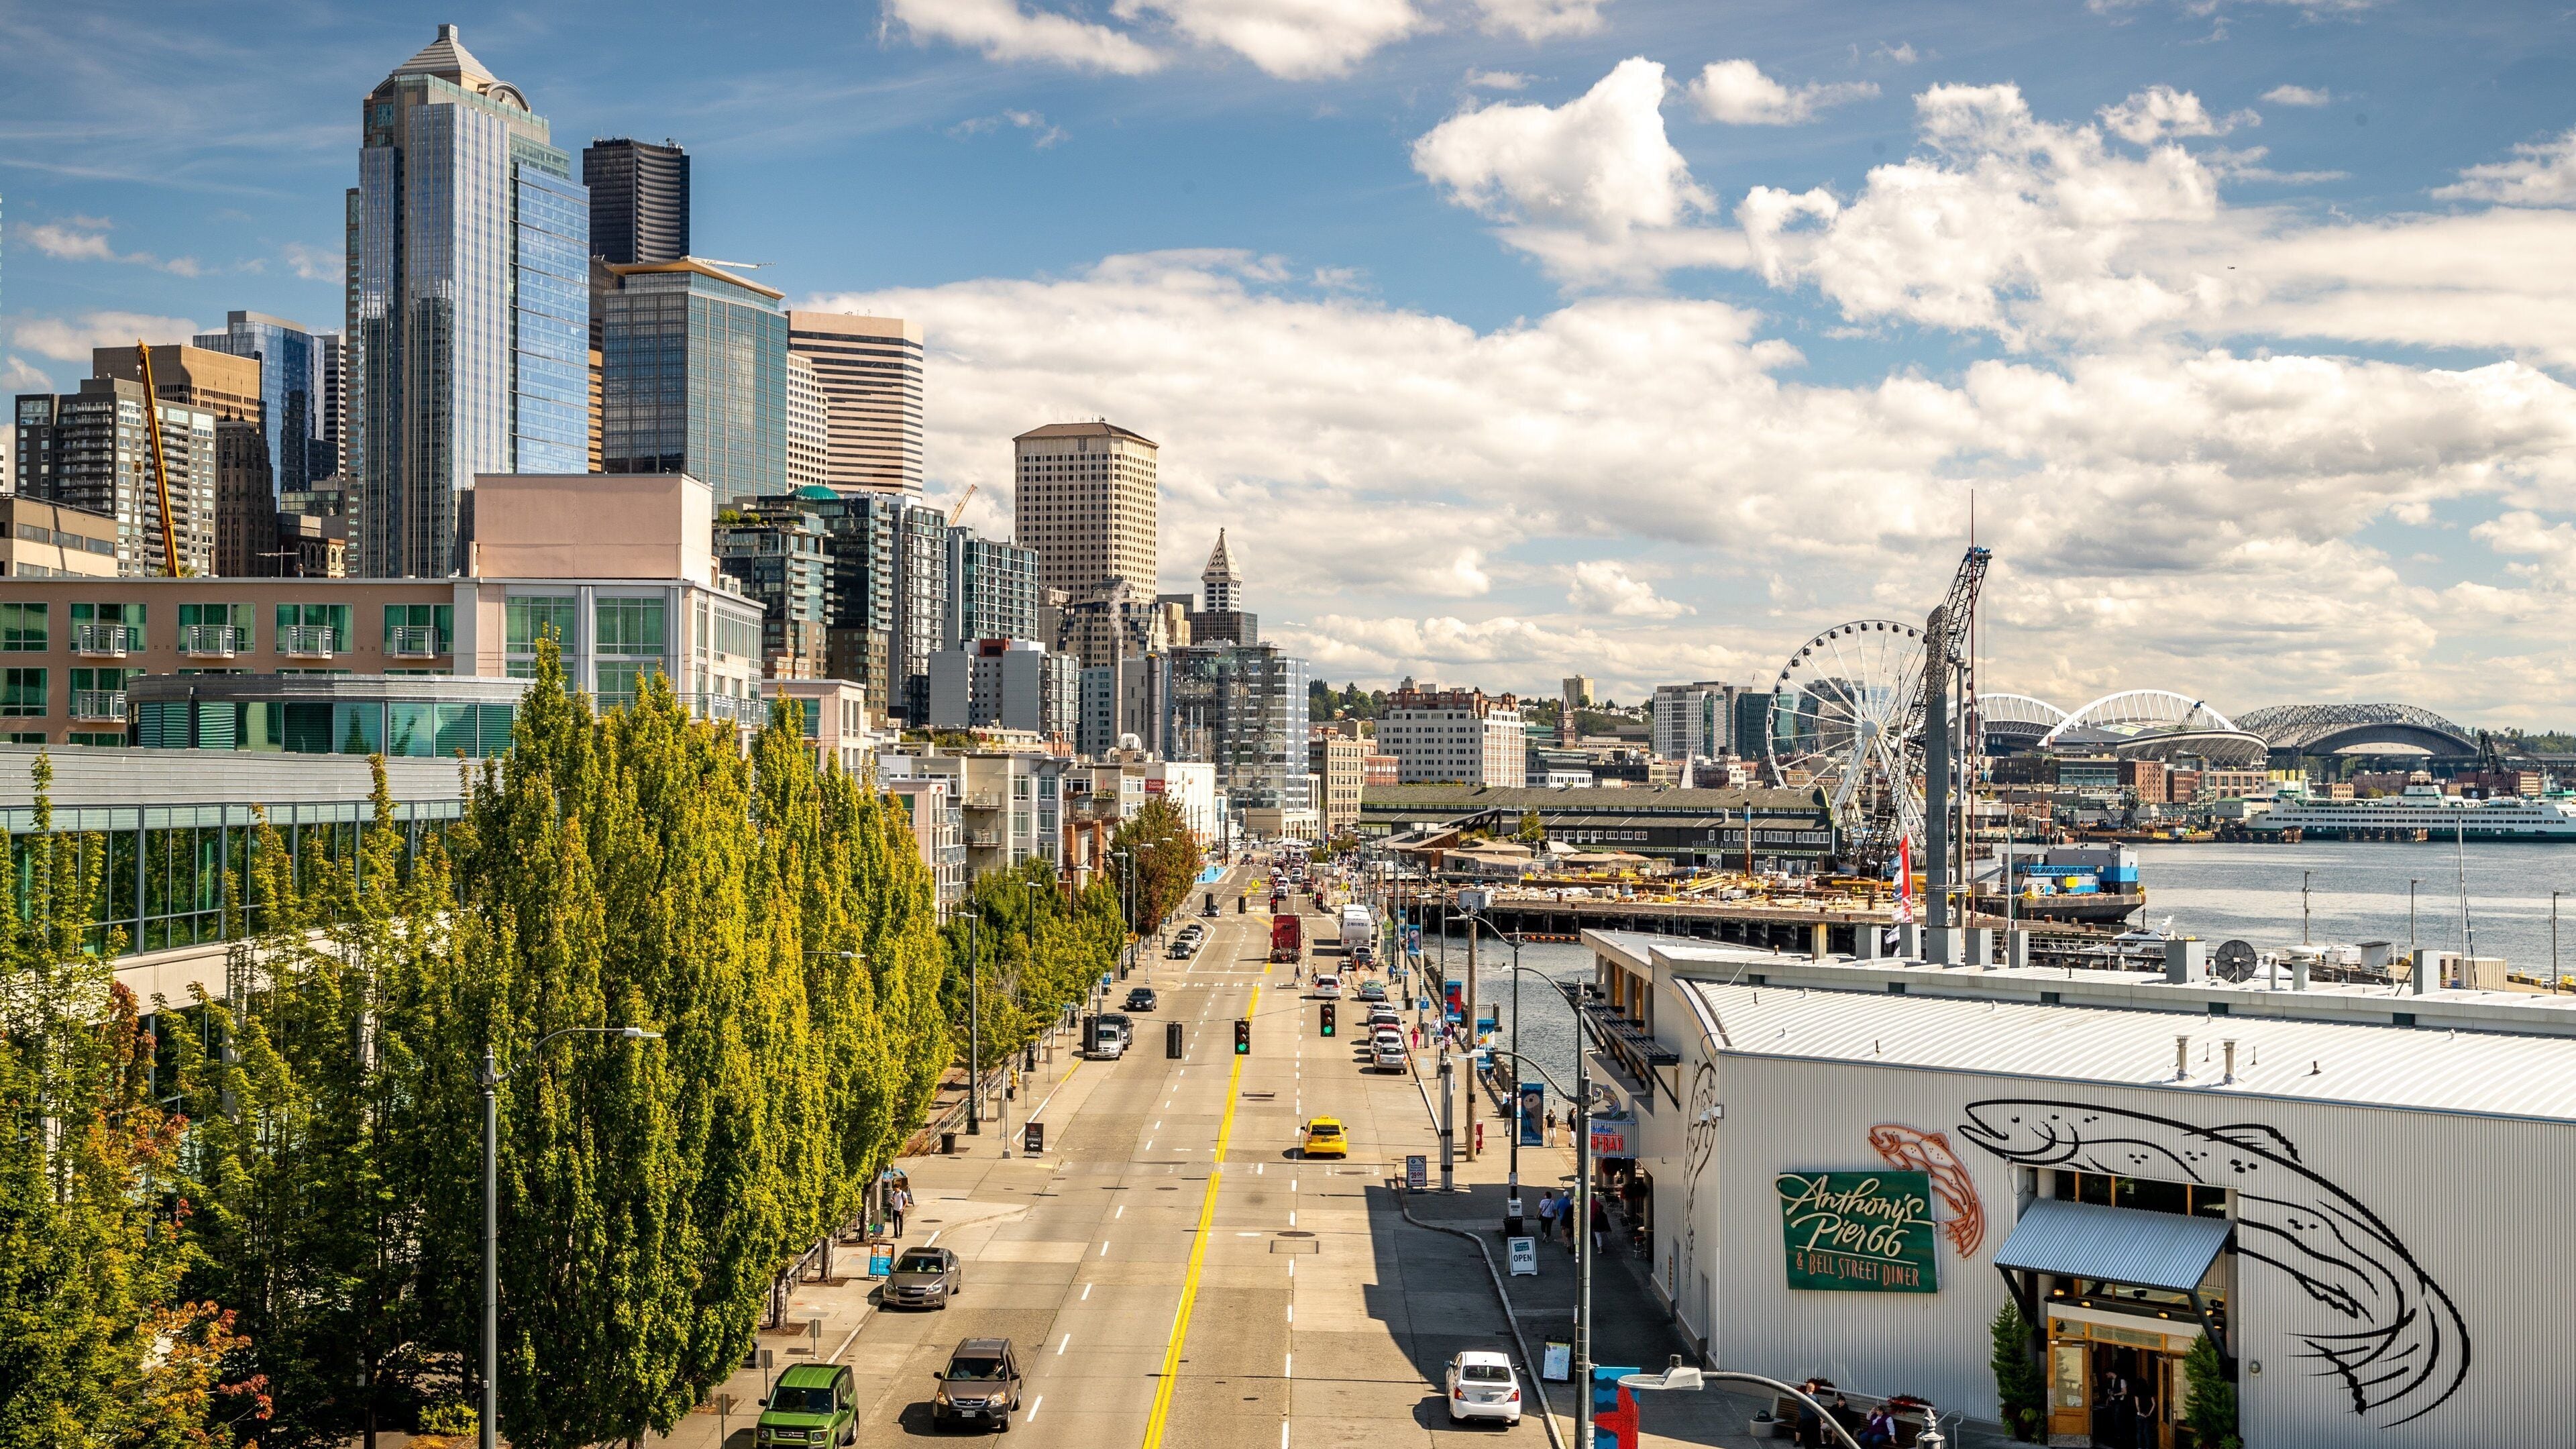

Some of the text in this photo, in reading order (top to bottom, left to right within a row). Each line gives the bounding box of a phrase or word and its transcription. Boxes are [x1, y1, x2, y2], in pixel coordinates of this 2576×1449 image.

[1720, 841, 1755, 849] AQUARIM
[1602, 1136, 1623, 1153] BAR
[1773, 1174, 1937, 1230] Anthony's
[1791, 1213, 1910, 1258] Pier 66
[1513, 1254, 1532, 1263] OPEN
[1796, 1252, 1919, 1287] & BELL STREET DINER
